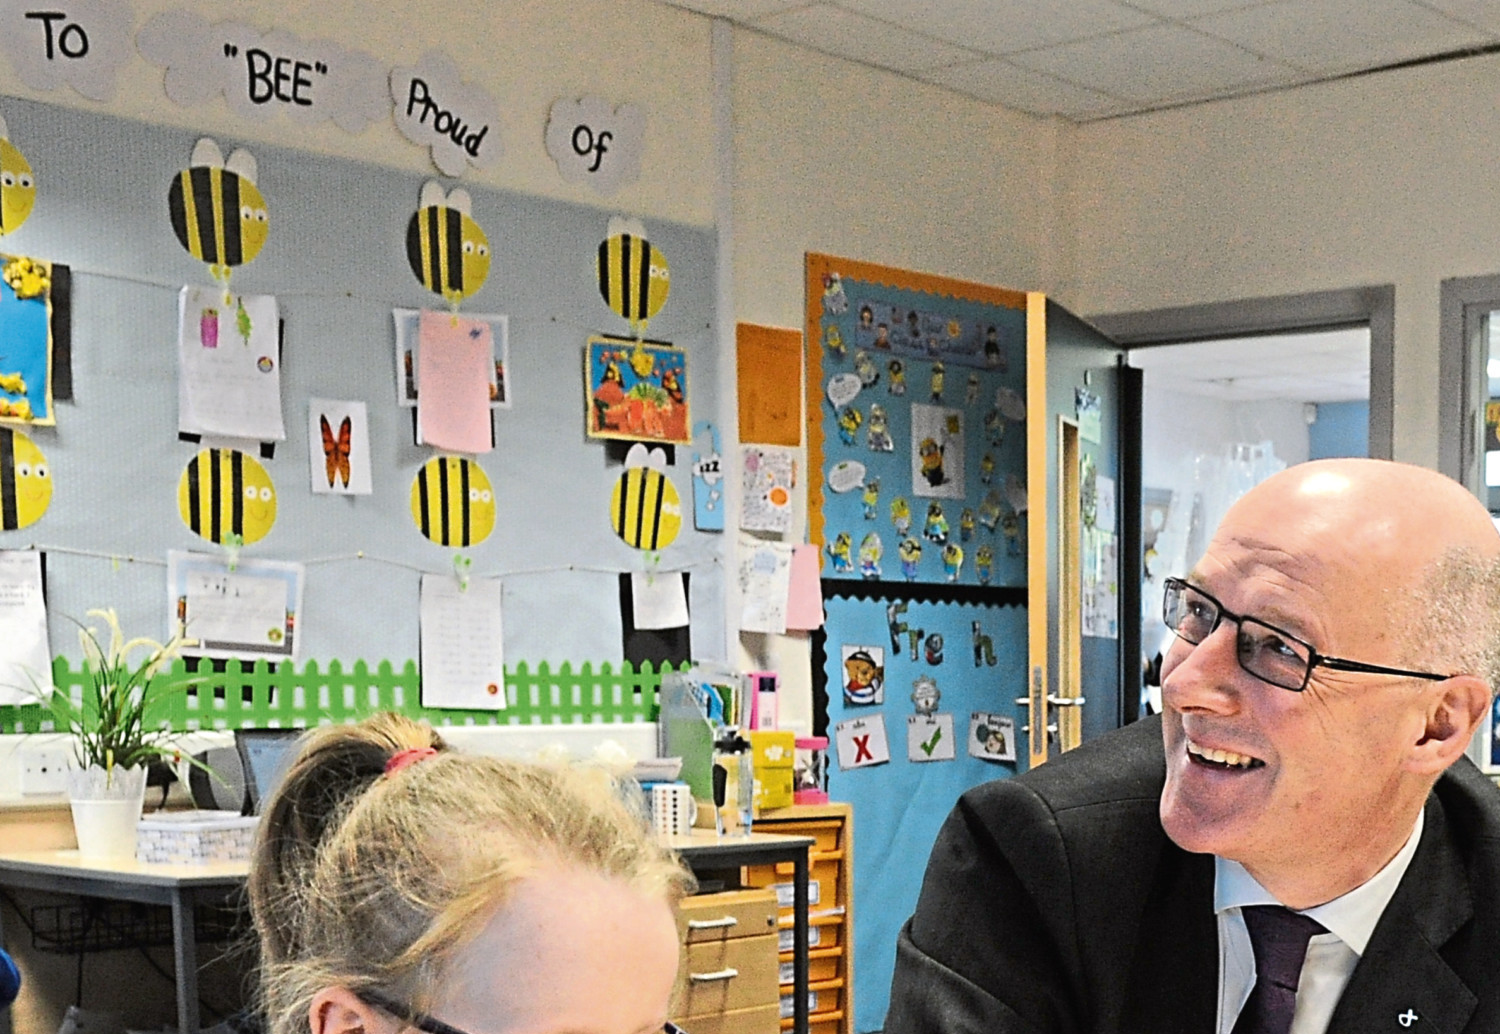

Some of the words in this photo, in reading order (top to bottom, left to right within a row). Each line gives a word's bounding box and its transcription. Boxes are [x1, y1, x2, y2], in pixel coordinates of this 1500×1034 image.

[26, 11, 90, 60] To
[223, 43, 328, 106] "BEE"
[406, 78, 488, 158] Proud
